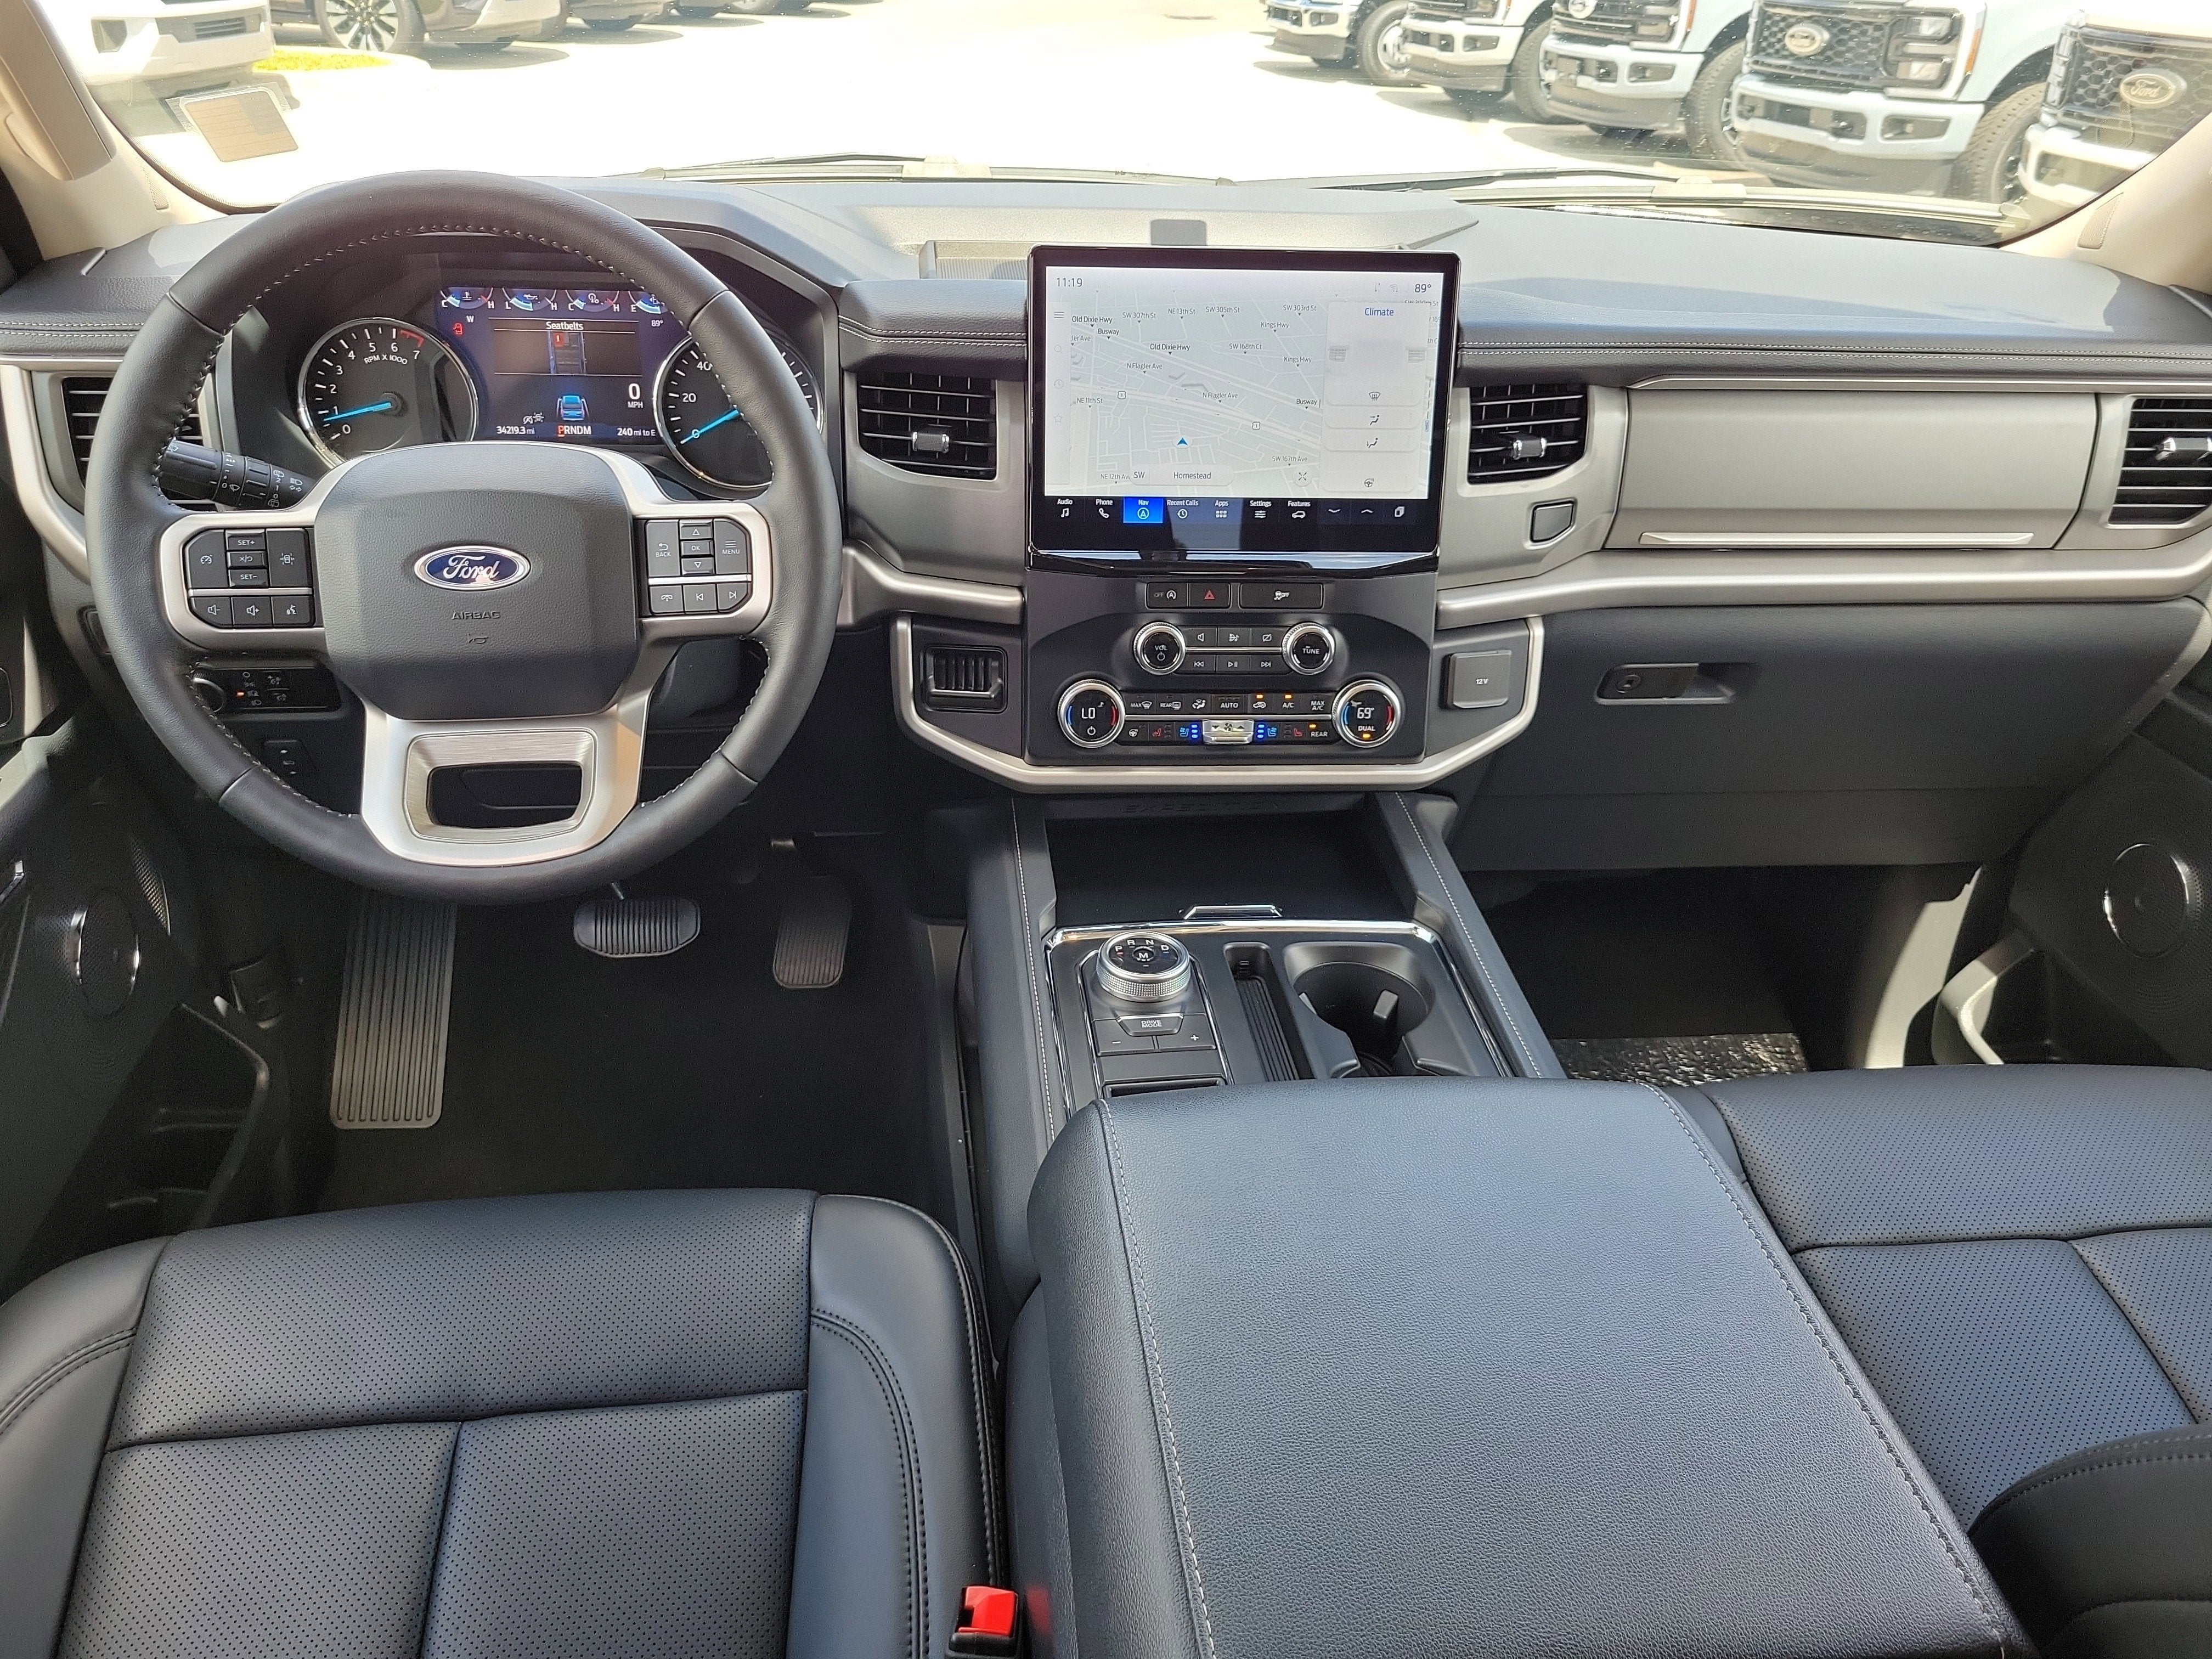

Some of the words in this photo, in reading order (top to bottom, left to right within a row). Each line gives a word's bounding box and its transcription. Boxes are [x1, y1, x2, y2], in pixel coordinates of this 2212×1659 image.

[1057, 278, 1083, 287] 11:19
[1414, 284, 1432, 293] 89°
[1364, 308, 1394, 316] Climate
[546, 321, 584, 330] Seatbelts
[369, 343, 376, 352] 5
[391, 342, 398, 352] 6
[348, 350, 356, 360] 4
[364, 354, 380, 364] RPM
[390, 354, 408, 365] 1000
[413, 350, 420, 360] 7
[336, 365, 343, 375] 3
[697, 362, 712, 371] 40
[329, 385, 337, 393] 2
[629, 383, 640, 399] 0
[682, 393, 696, 403] 20
[333, 406, 338, 415] 1
[342, 425, 351, 434] 0
[496, 426, 526, 435] 34219.3
[617, 428, 633, 436] 240
[692, 429, 700, 438] 0
[443, 555, 500, 579] Ford
[452, 611, 500, 620] AIRBAG
